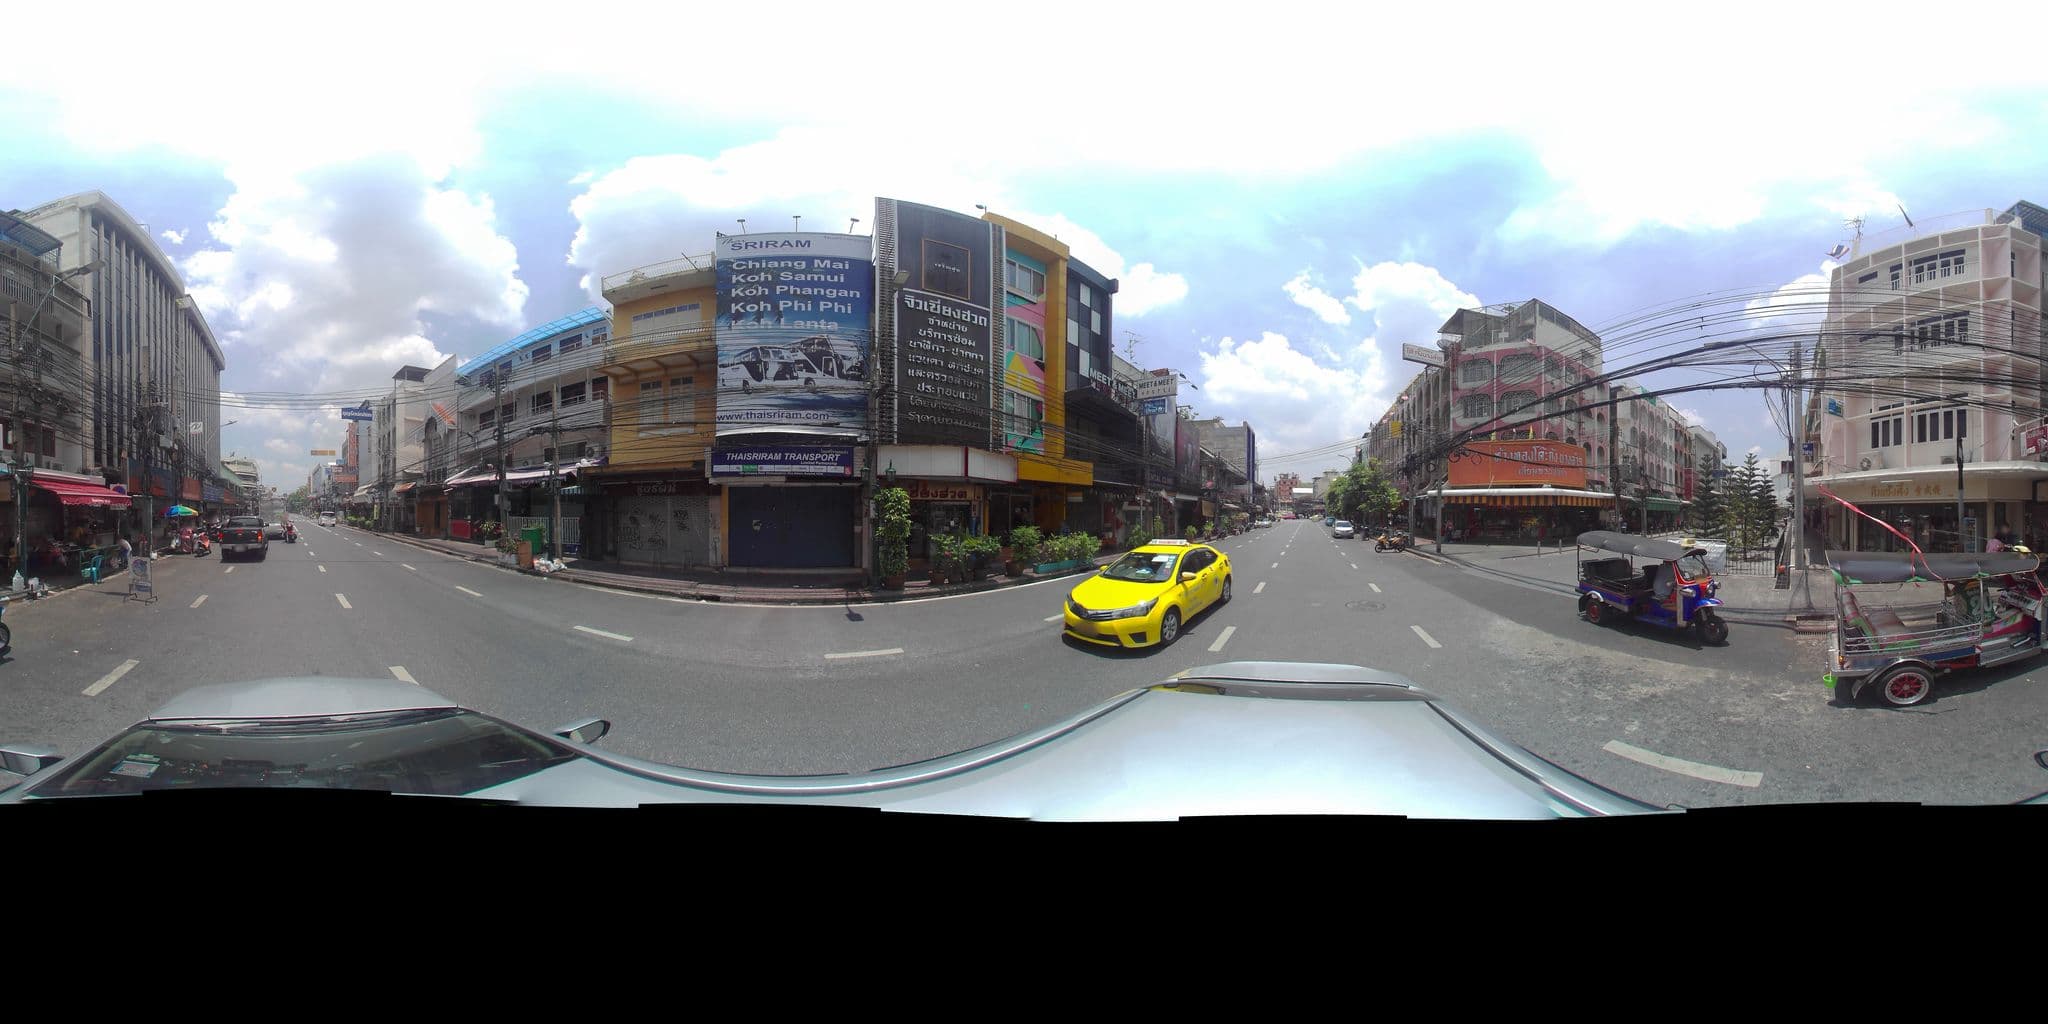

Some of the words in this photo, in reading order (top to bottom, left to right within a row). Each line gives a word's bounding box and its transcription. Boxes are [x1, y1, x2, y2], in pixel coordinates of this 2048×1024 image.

[731, 239, 811, 250] SRIRAM
[732, 260, 806, 271] Chiang
[814, 259, 850, 270] Mai
[731, 272, 772, 284] Koh
[779, 271, 845, 283] Samui
[731, 285, 769, 298] Koh
[776, 285, 860, 298] Phangan
[731, 301, 771, 314] Koh
[779, 300, 812, 312] Phi
[819, 301, 852, 314] Phi
[731, 319, 772, 331] Koh
[780, 317, 838, 331] Lanta
[1089, 367, 1112, 388] MEET
[717, 410, 830, 421] www.thaisriram.com
[726, 453, 782, 461] THAISRIRAM
[784, 453, 841, 462] TRANSPORT
